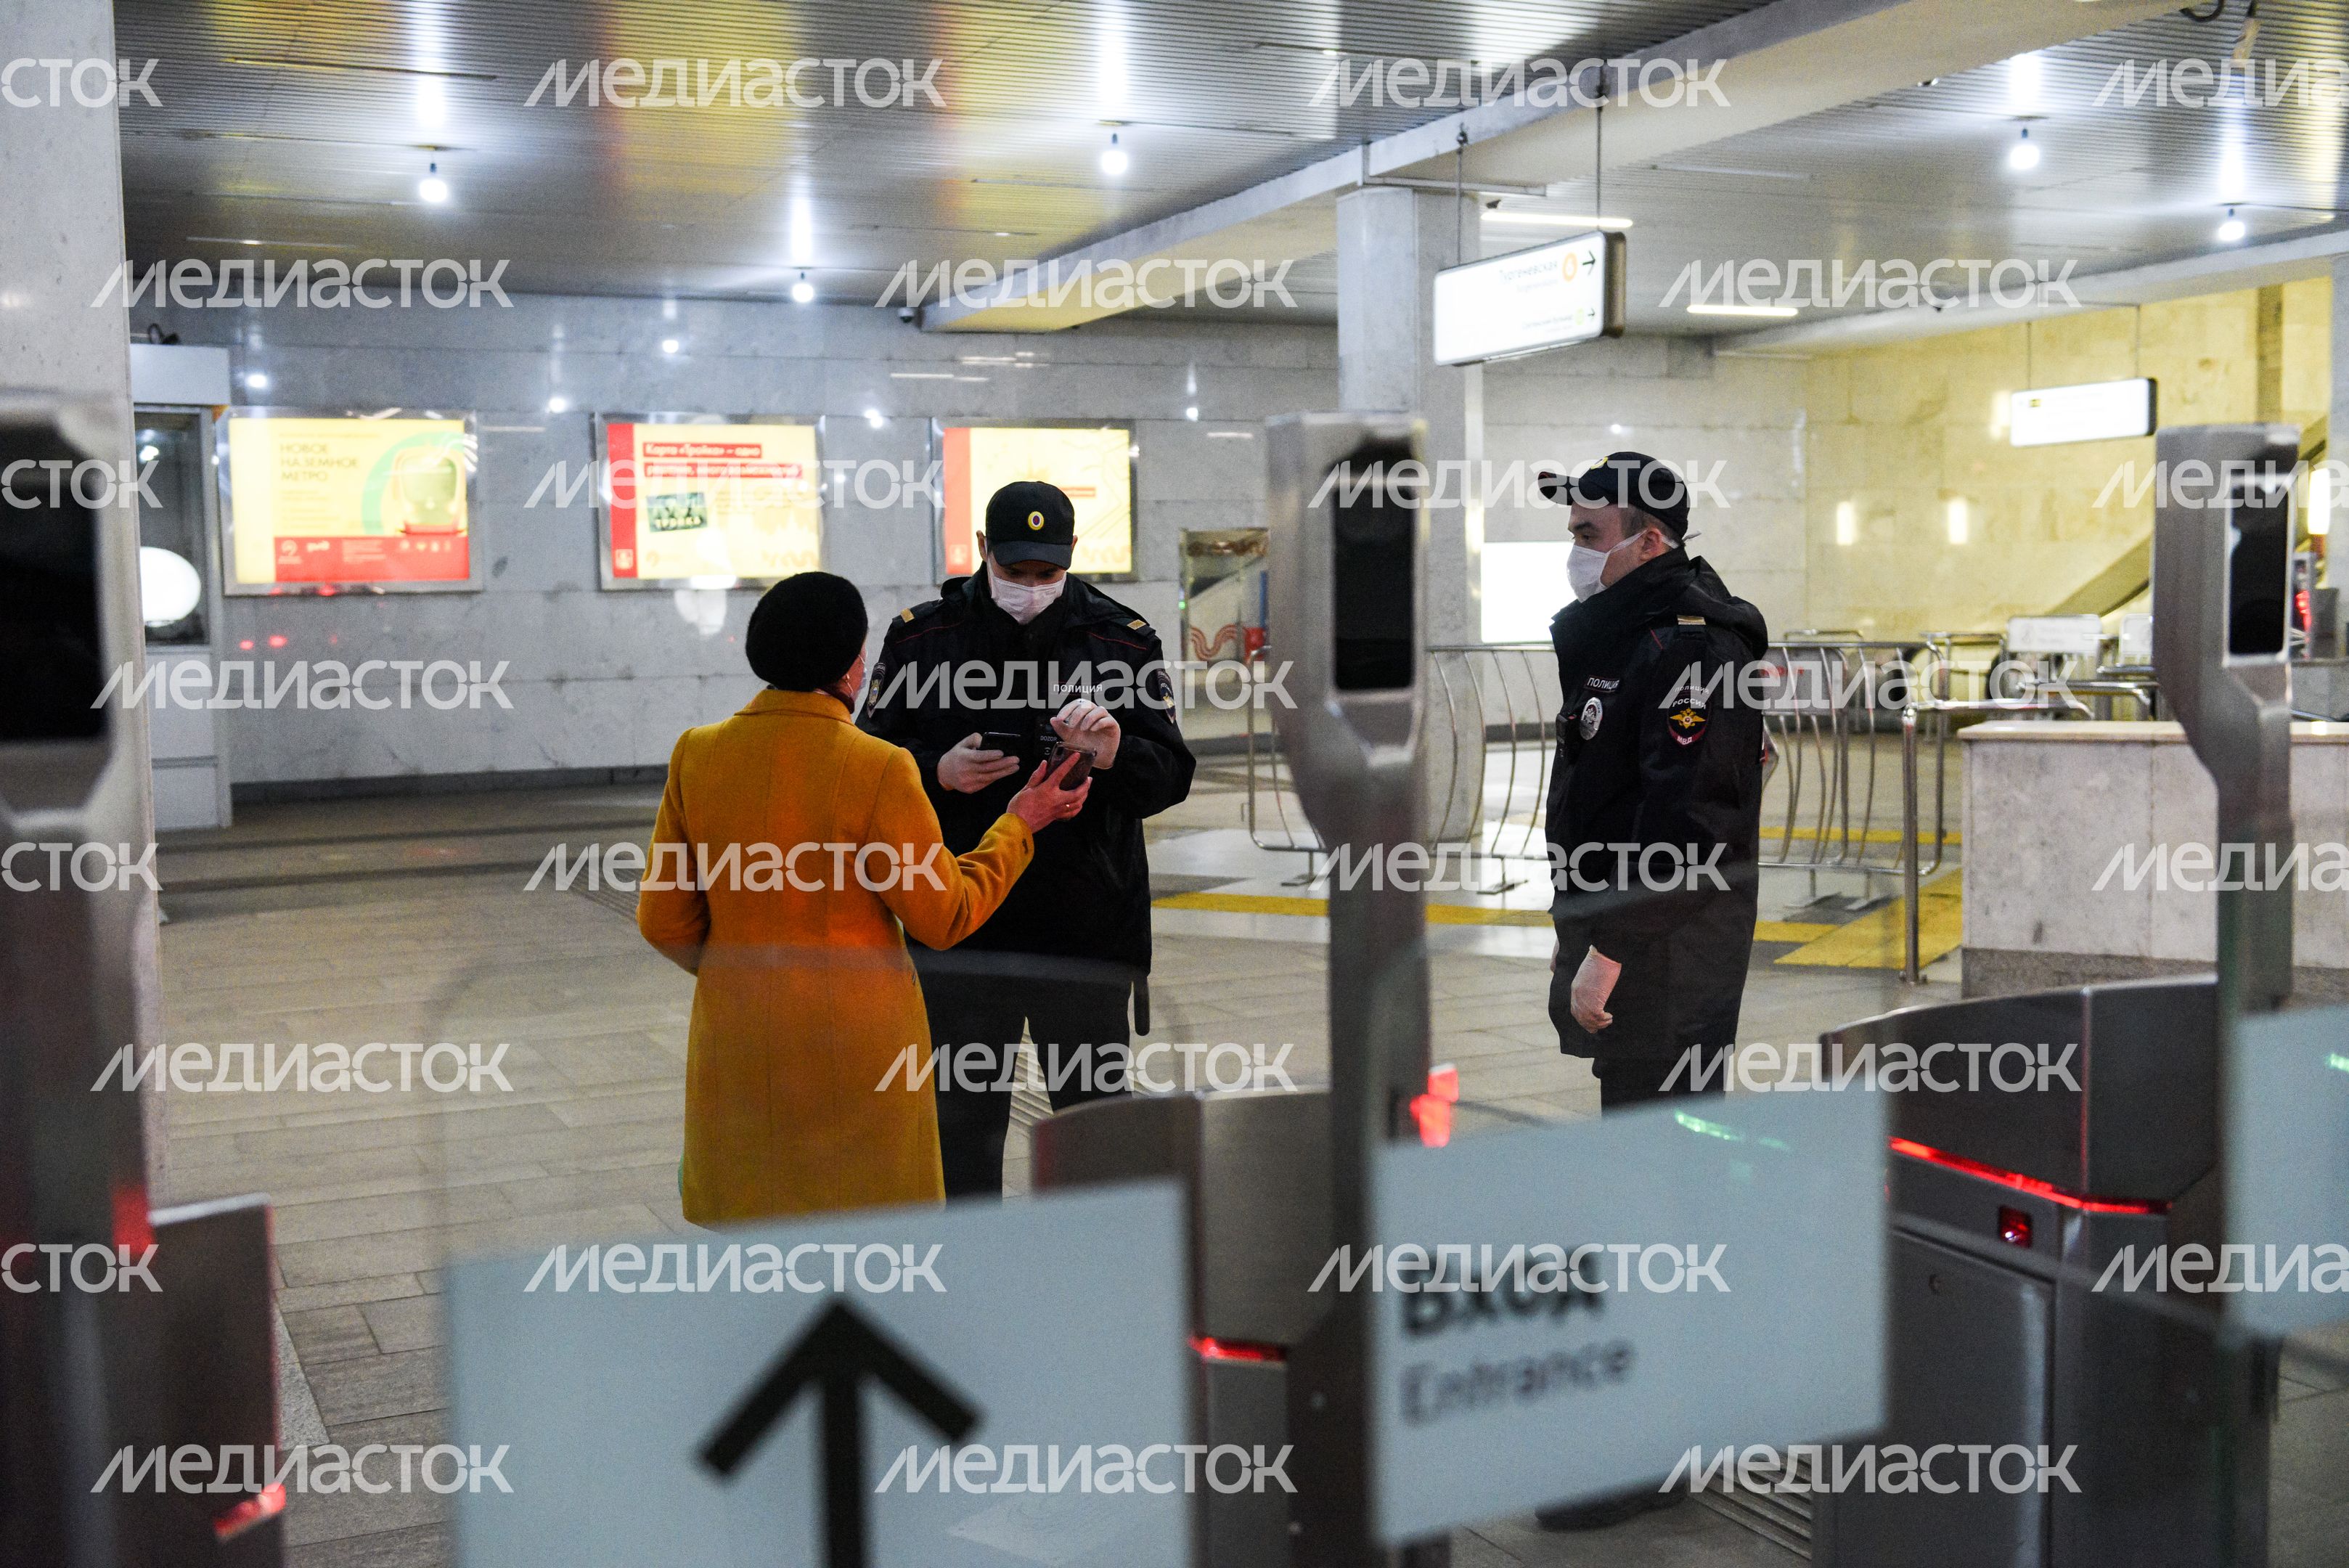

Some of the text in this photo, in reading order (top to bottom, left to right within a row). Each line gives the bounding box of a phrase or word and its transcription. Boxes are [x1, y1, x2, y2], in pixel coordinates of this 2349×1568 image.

[280, 442, 328, 454] НОВОЕ
[280, 456, 359, 469] НАЗЕМНОЕ
[281, 470, 328, 483] МЕТРО
[1053, 684, 1103, 694] ПОЛИЦИЯ
[1672, 698, 1707, 709] РОССИЯ
[1677, 735, 1693, 746] МВД
[1402, 1339, 1634, 1424] Entrance
